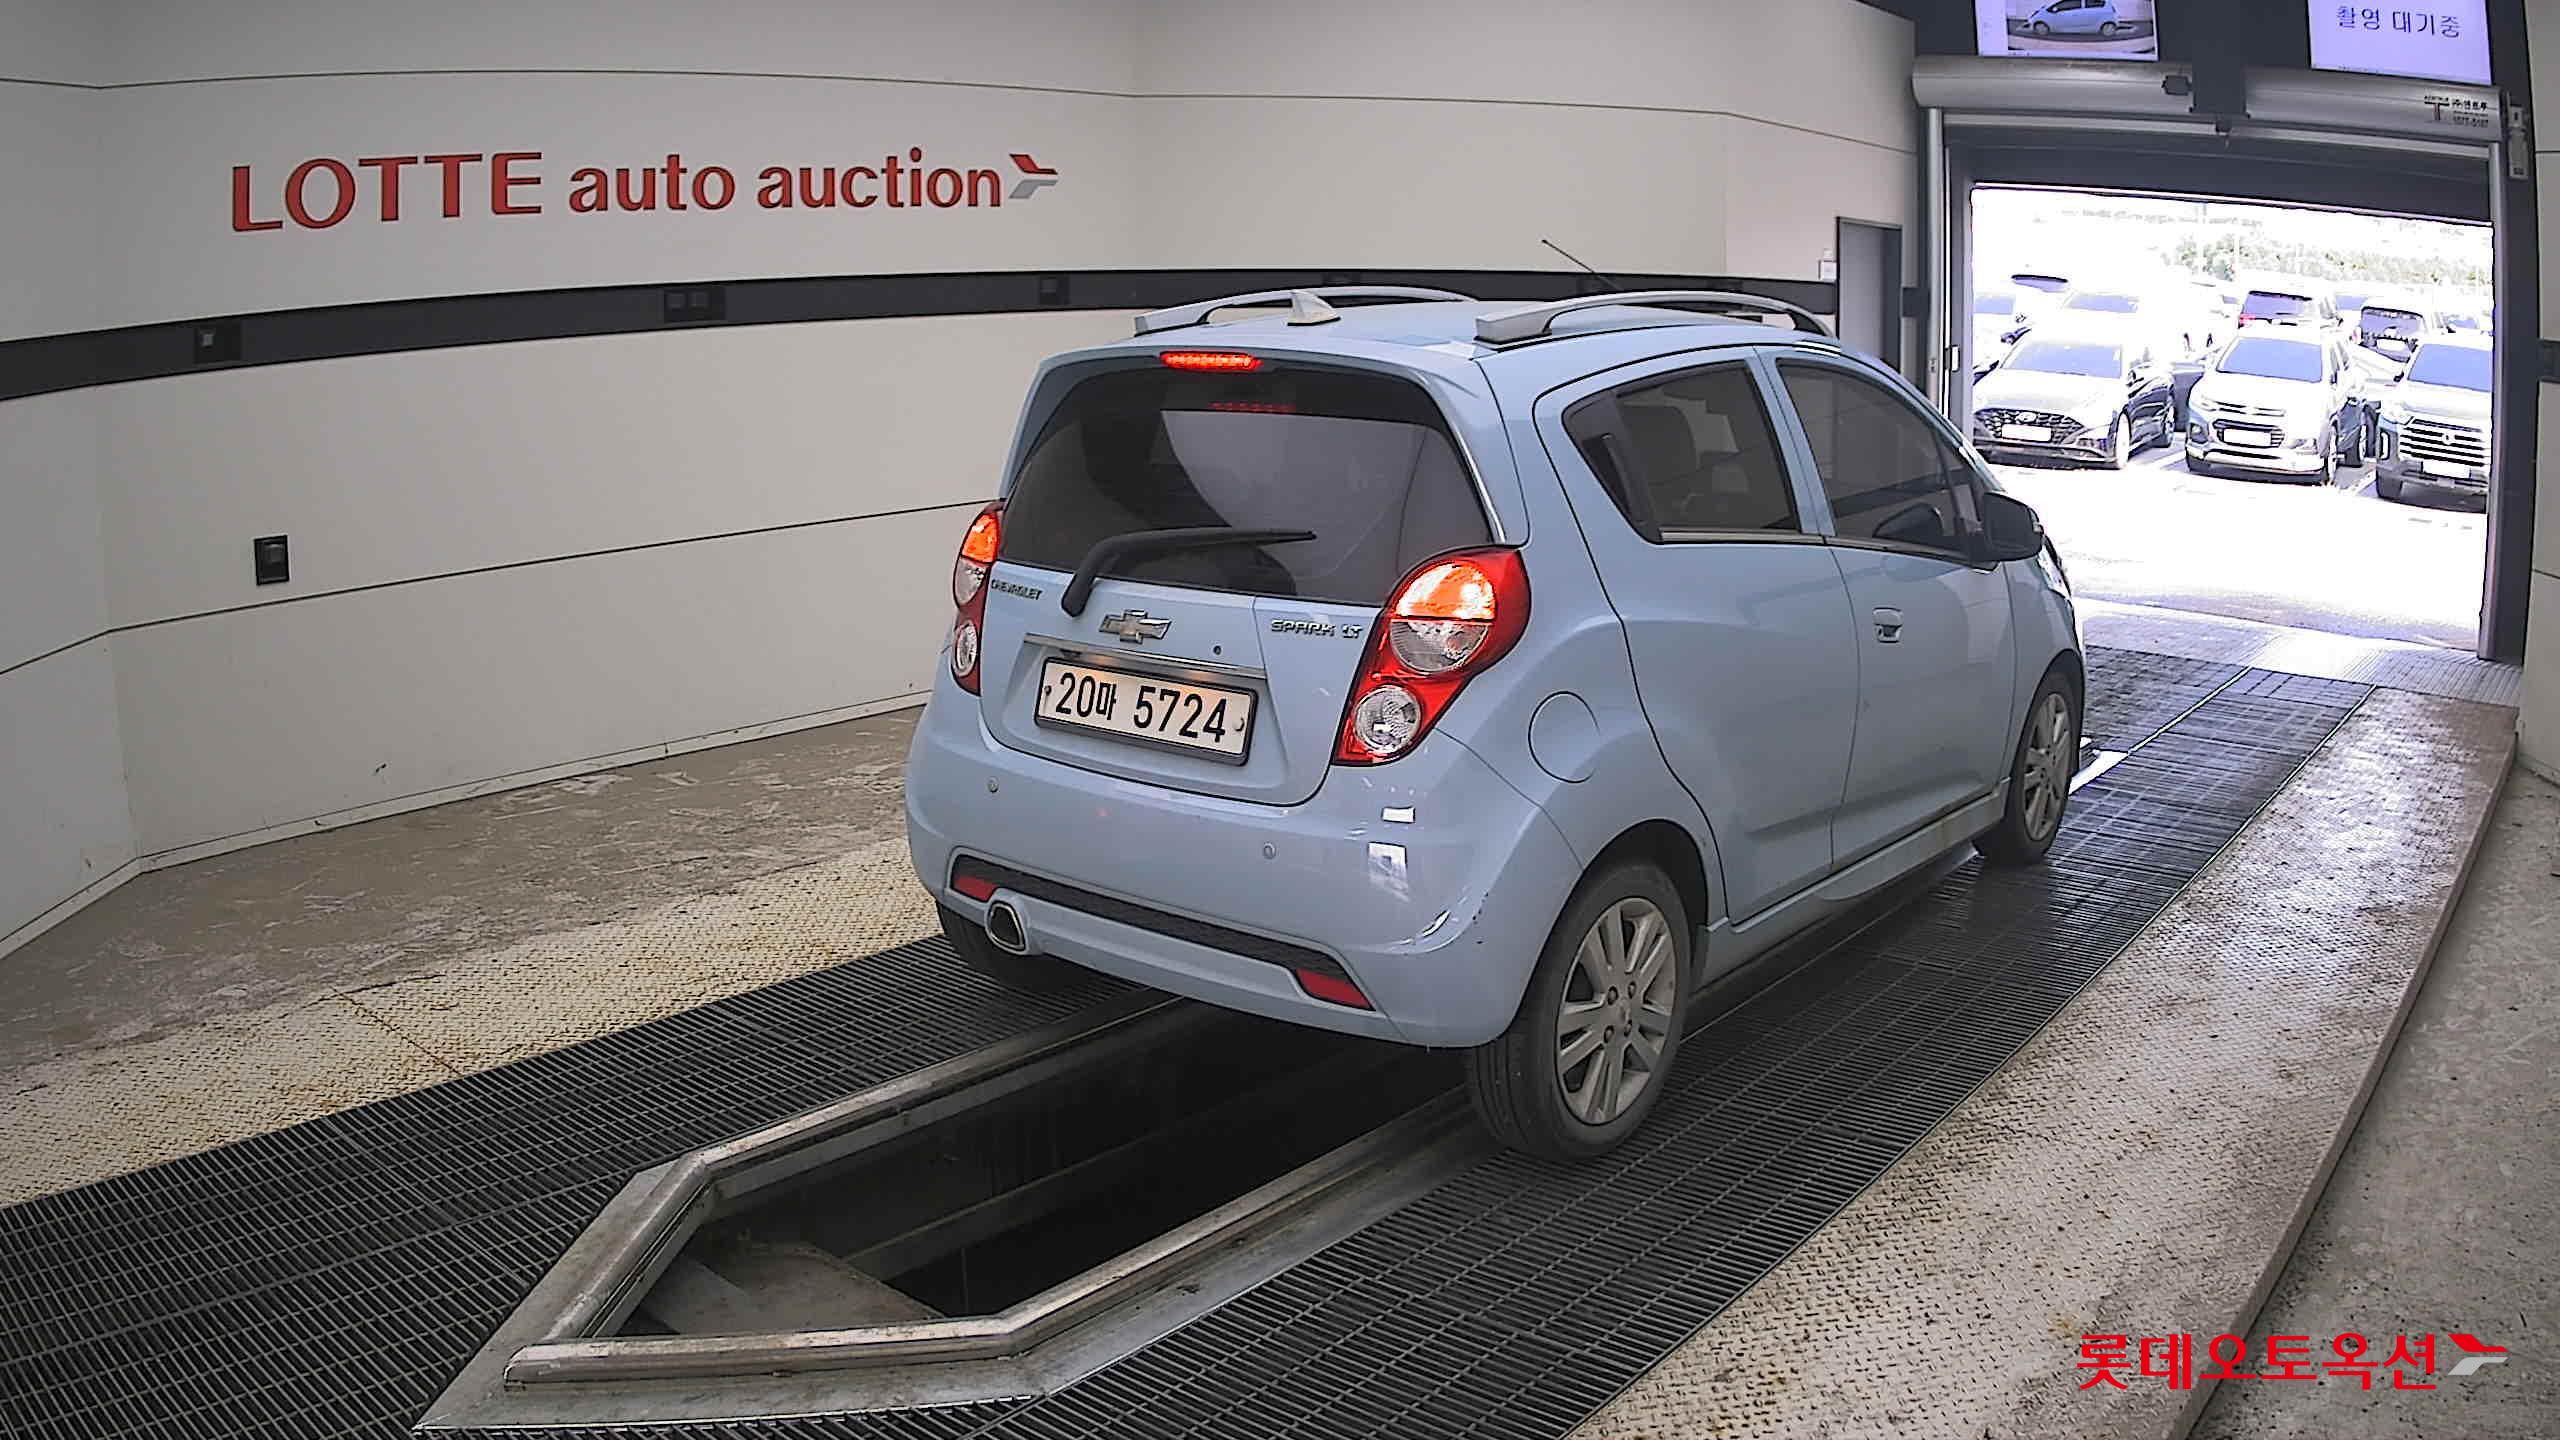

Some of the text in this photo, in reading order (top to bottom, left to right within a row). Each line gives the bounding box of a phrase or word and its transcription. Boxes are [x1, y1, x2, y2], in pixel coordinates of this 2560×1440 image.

[2337, 5, 2460, 39] 촬영 대기중
[232, 147, 1002, 232] LOTTE auto auction
[991, 579, 1043, 600] CHEVROLET
[1271, 619, 1363, 639] SPARK LT
[1055, 672, 1228, 743] 20마 5724
